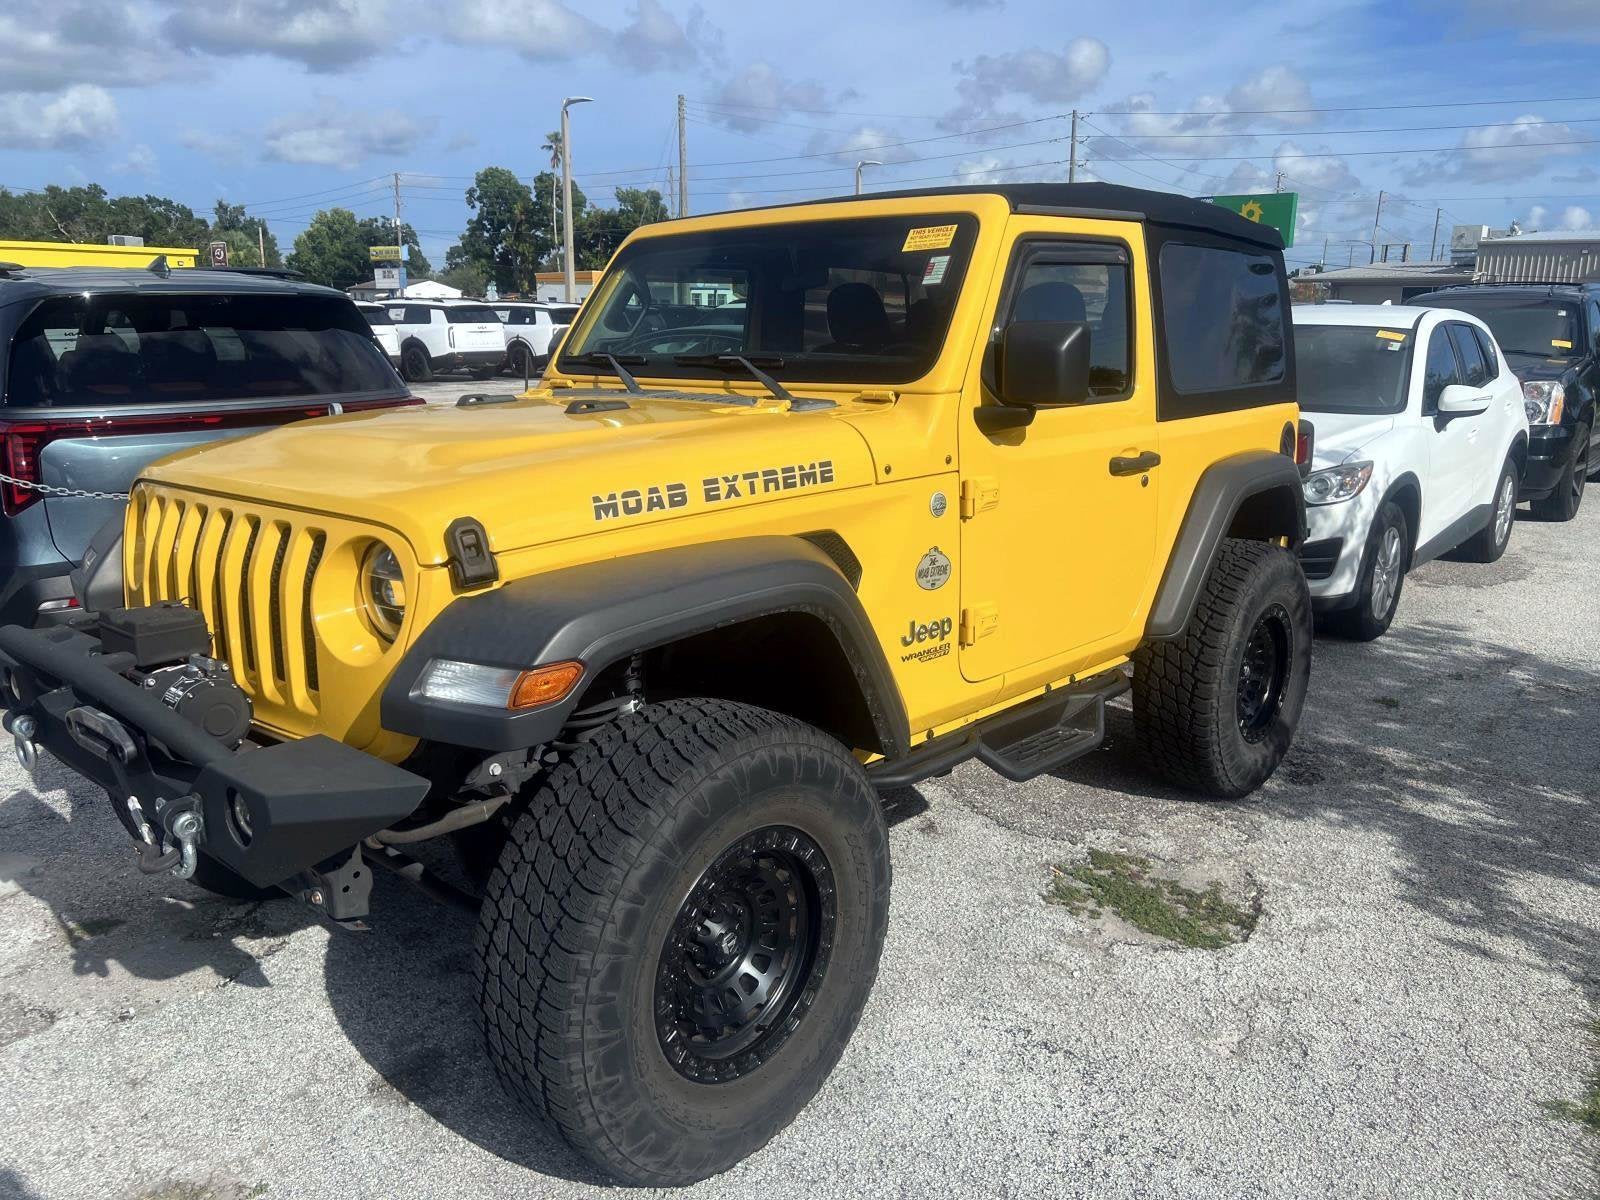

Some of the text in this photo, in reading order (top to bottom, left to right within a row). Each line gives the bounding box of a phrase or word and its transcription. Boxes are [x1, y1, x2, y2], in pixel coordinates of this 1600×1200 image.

[927, 226, 955, 235] VEHICLE
[591, 460, 834, 521] MOAB EXTREME
[901, 617, 953, 647] Jeep
[901, 642, 951, 662] WRANGLER
